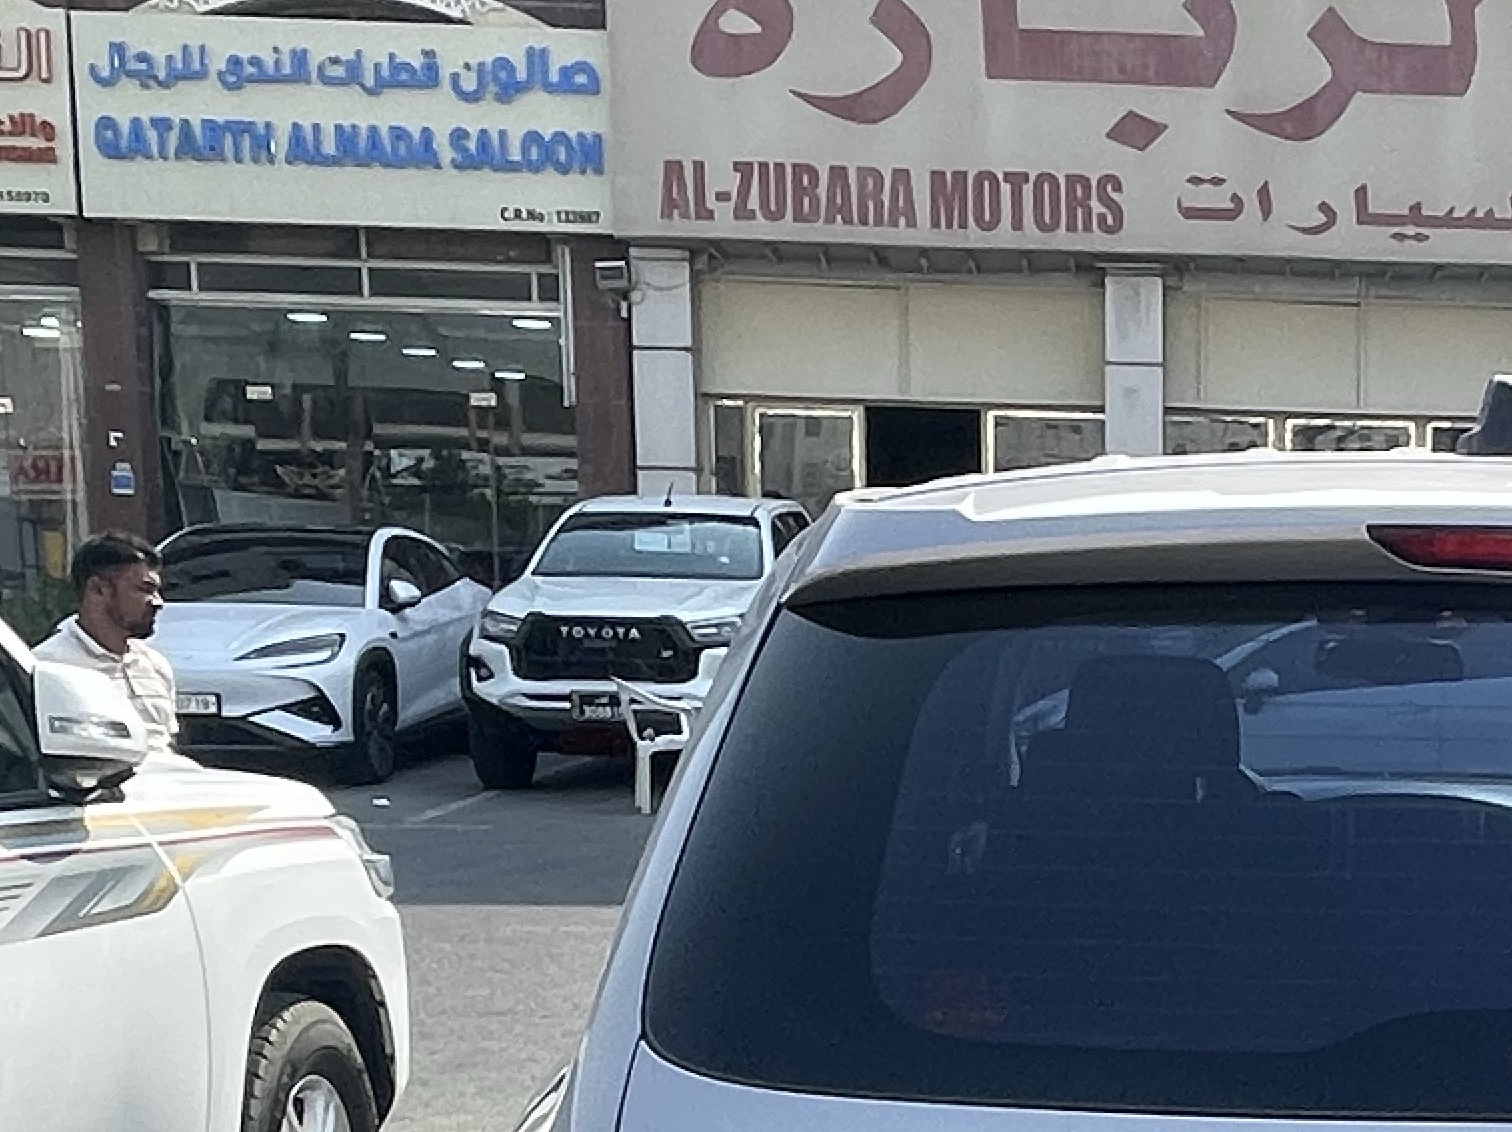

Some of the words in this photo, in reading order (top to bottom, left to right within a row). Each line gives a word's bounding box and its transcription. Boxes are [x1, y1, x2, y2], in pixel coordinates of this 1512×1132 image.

[88, 40, 210, 90] للرجال
[317, 48, 443, 95] قطرات
[450, 45, 602, 104] صالون
[448, 126, 605, 176] SALOON
[660, 159, 918, 231] AL-ZUBARA
[929, 169, 1125, 235] MOTORS
[559, 625, 642, 640] TOYOTA
